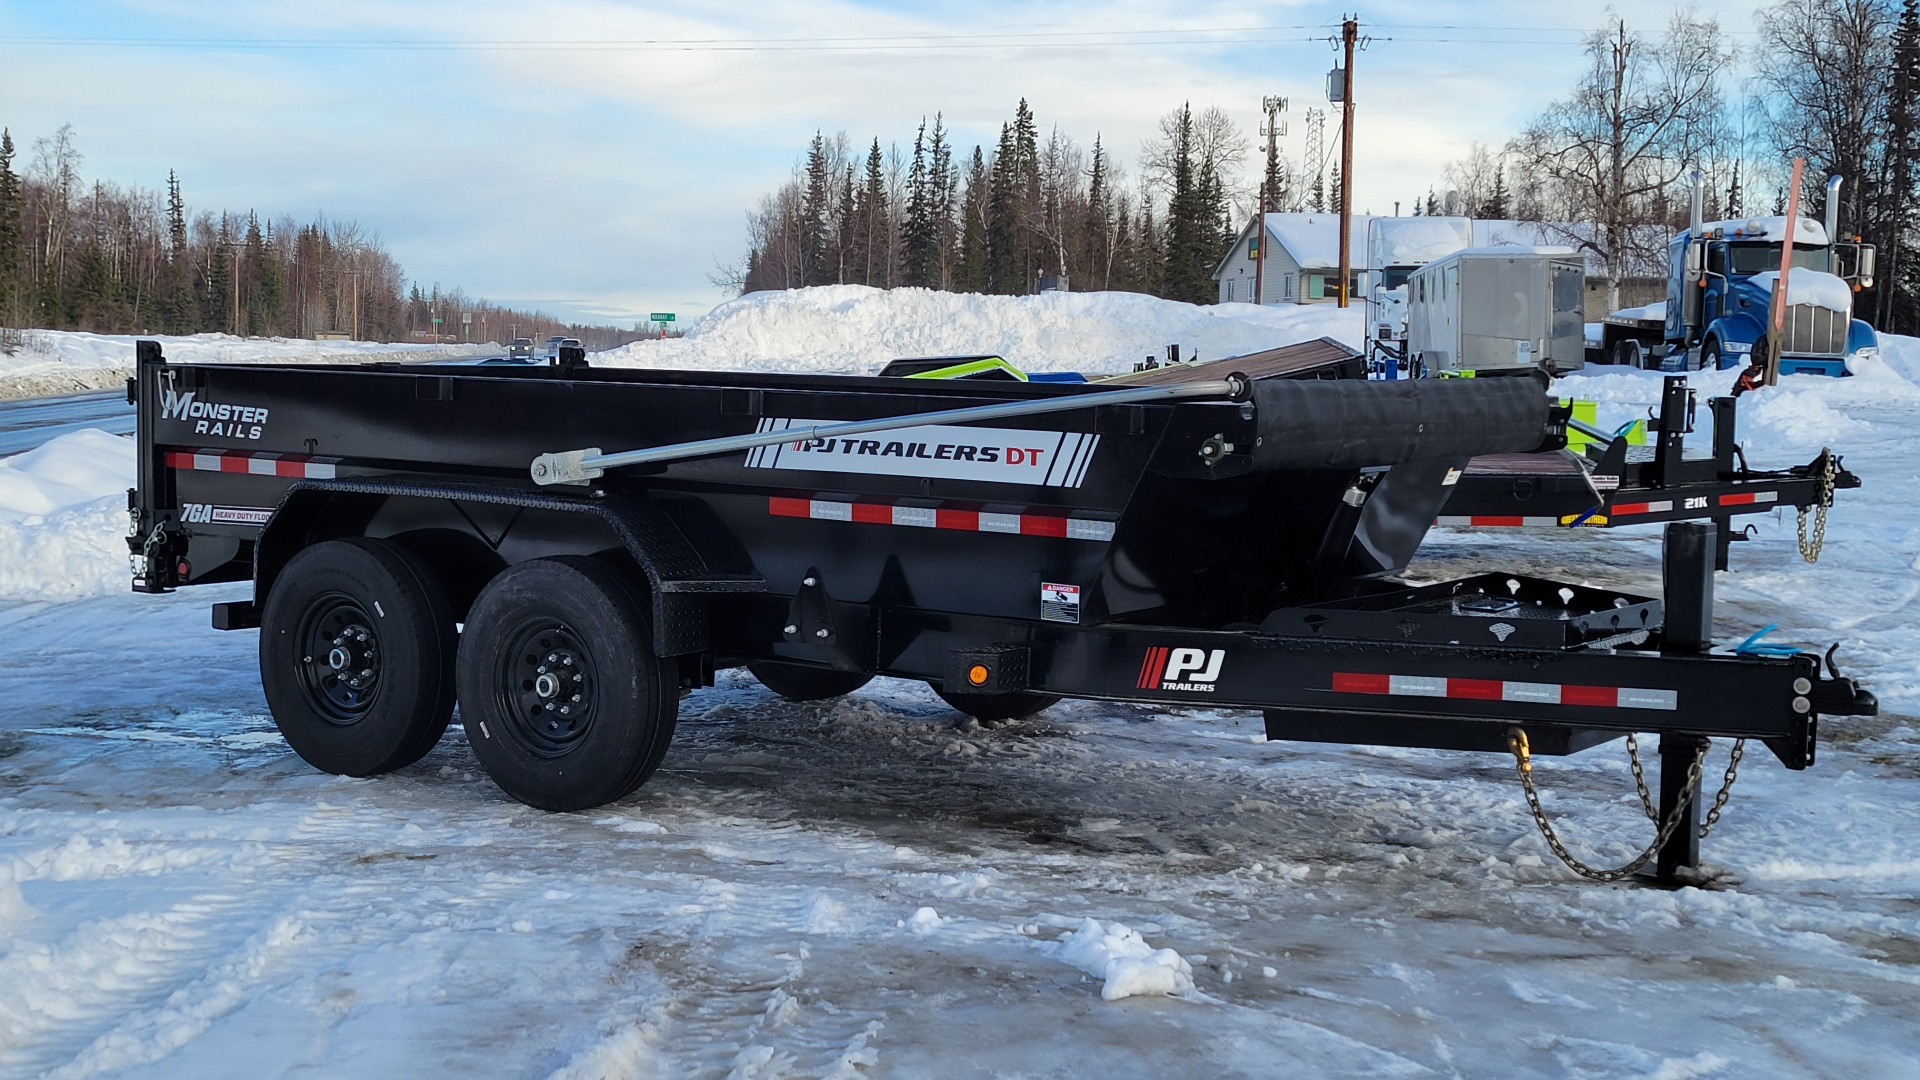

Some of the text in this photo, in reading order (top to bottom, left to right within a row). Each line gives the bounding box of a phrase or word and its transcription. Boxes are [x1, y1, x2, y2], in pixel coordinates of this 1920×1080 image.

[162, 389, 269, 424] MONSTER
[195, 420, 262, 439] RAILS
[1006, 447, 1044, 466] DT
[1684, 496, 1708, 509] 21K
[180, 503, 270, 523] 7GA HEAVY DUTY FLOO
[1052, 585, 1074, 593] DANGER
[1164, 648, 1226, 681] PJ
[1162, 682, 1215, 692] TRAILERS
